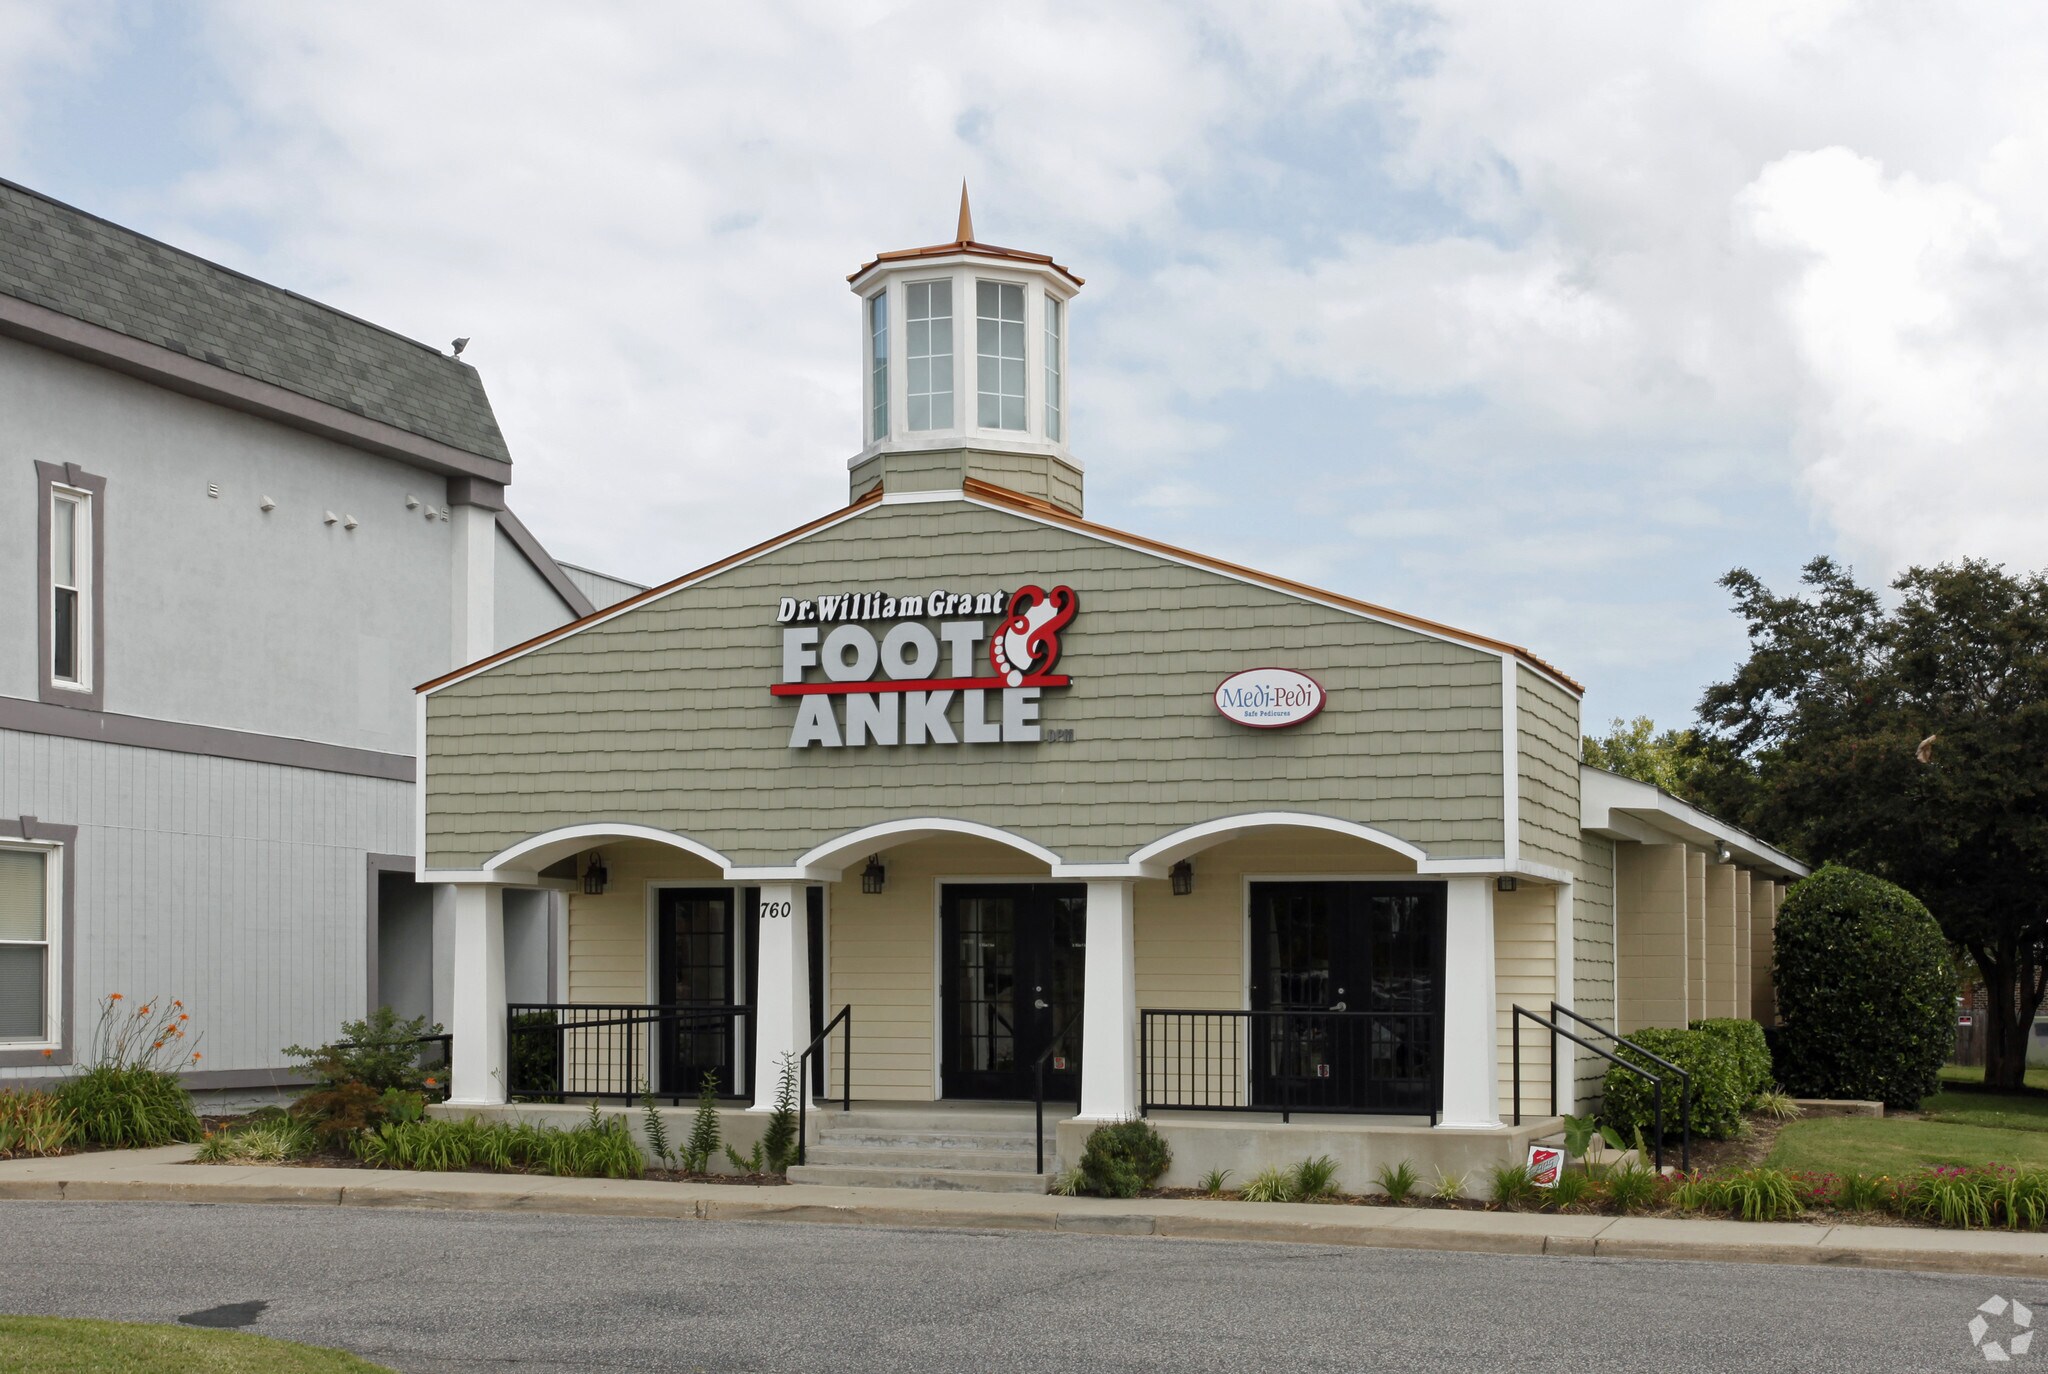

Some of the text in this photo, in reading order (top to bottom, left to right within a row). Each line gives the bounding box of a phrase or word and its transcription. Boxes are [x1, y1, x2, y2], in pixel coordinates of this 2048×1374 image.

[776, 589, 1005, 622] Dr. William Grant
[782, 620, 984, 683] FOOT
[1221, 684, 1312, 708] Medi-Pedi
[788, 687, 1041, 748] ANKLE
[760, 901, 791, 919] 760
